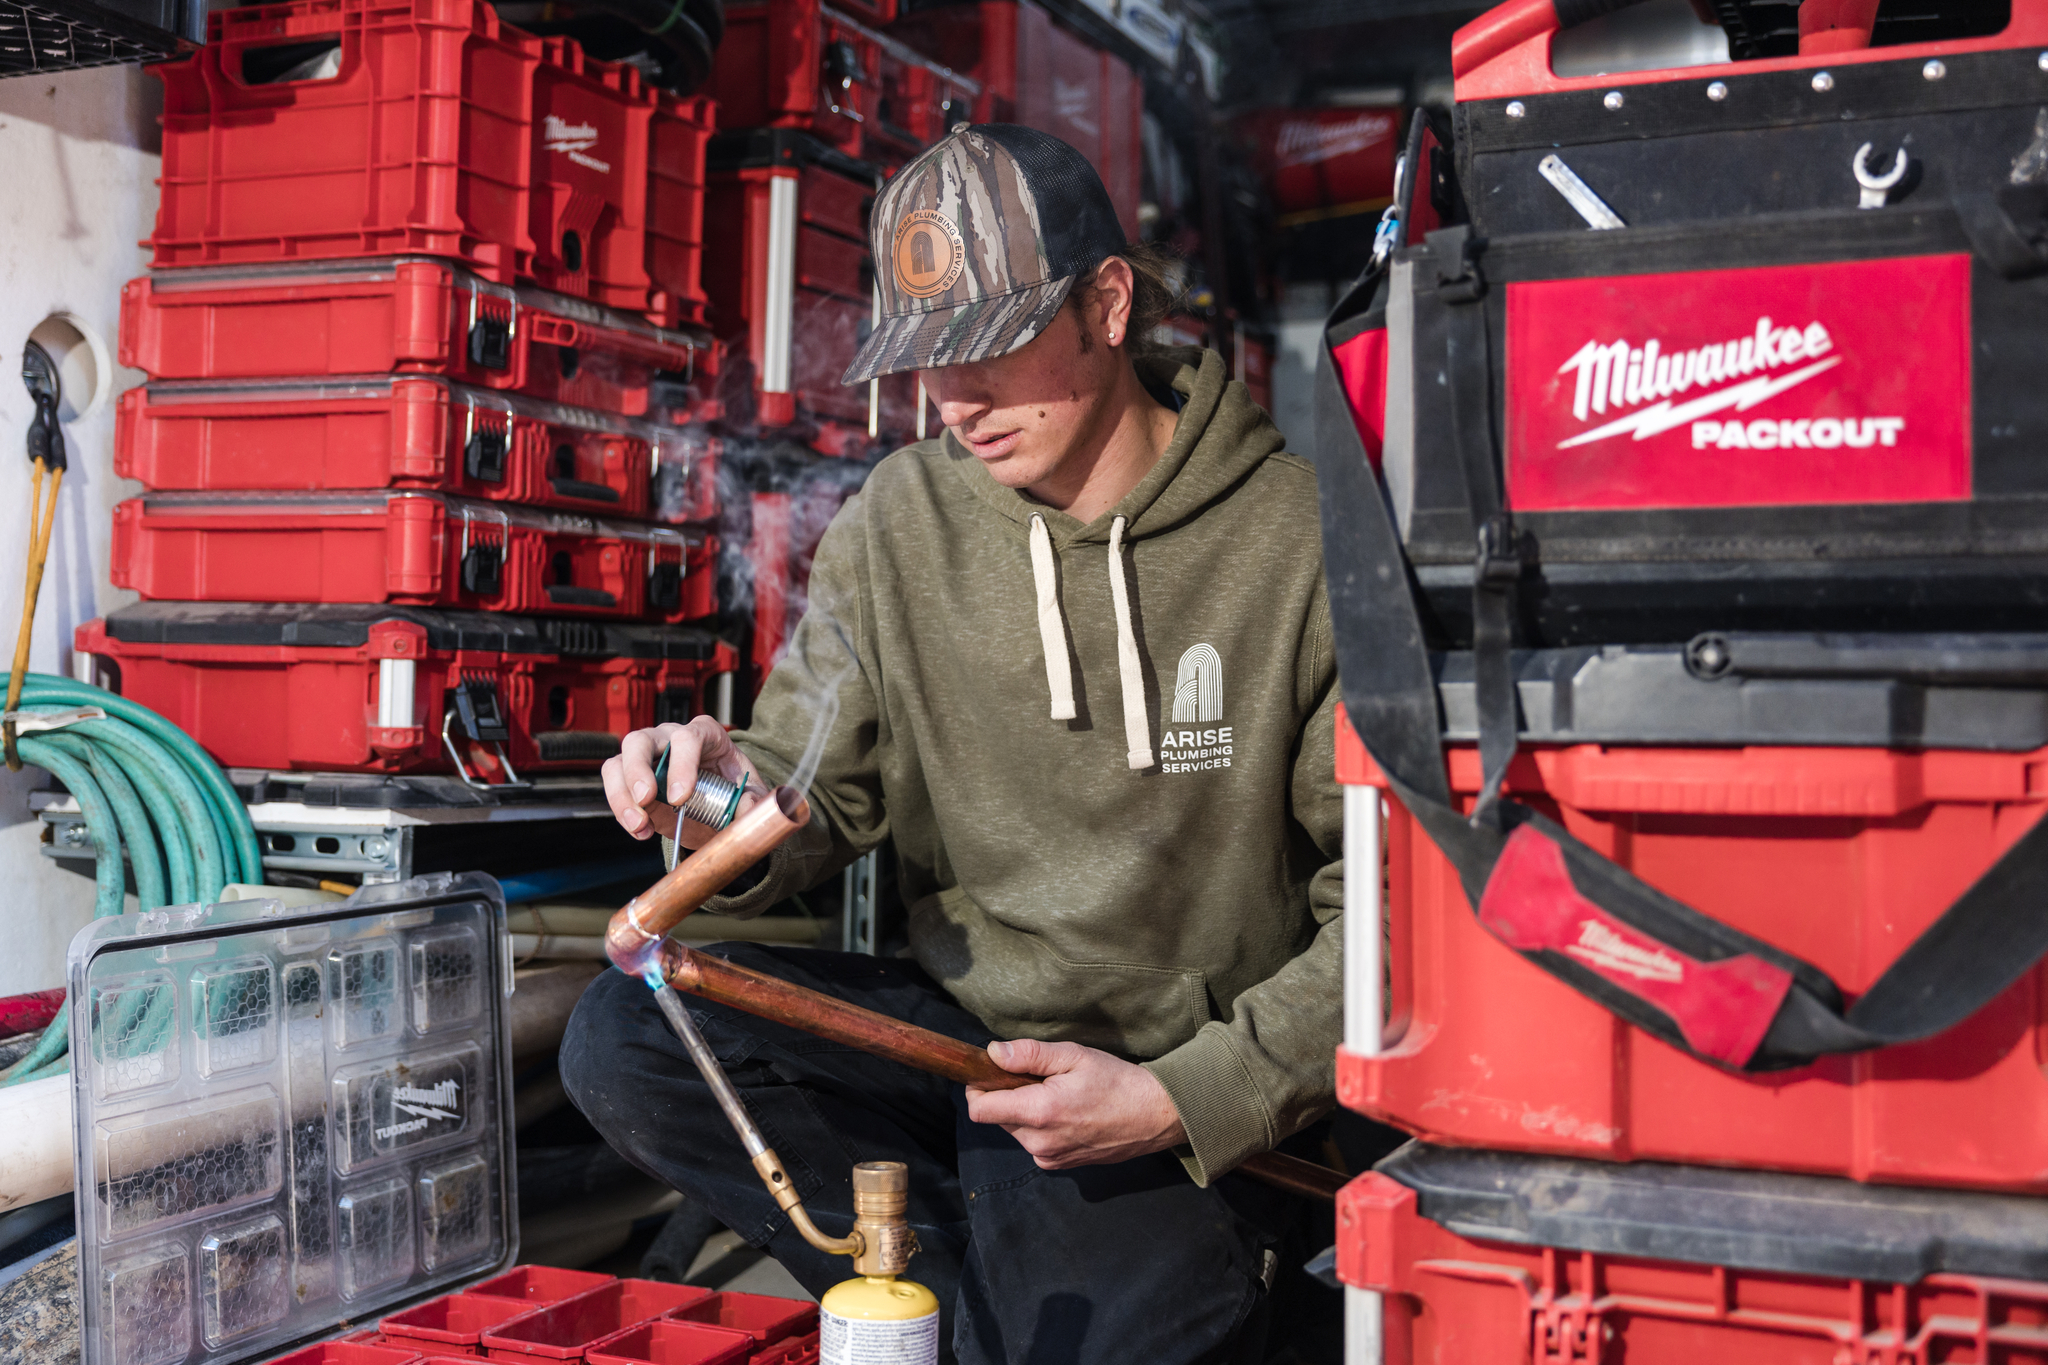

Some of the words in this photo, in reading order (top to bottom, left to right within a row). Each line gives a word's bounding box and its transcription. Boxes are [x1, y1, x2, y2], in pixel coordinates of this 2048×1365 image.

[896, 217, 912, 241] ARISE
[914, 212, 957, 236] PLUMBING
[943, 239, 962, 287] SERVICES
[1557, 315, 1833, 423] Milwaukee
[1691, 416, 1906, 450] PACKOUT
[1161, 727, 1233, 748] ARISE
[1161, 745, 1233, 760] PLUMBING
[1162, 758, 1232, 773] SERVICES
